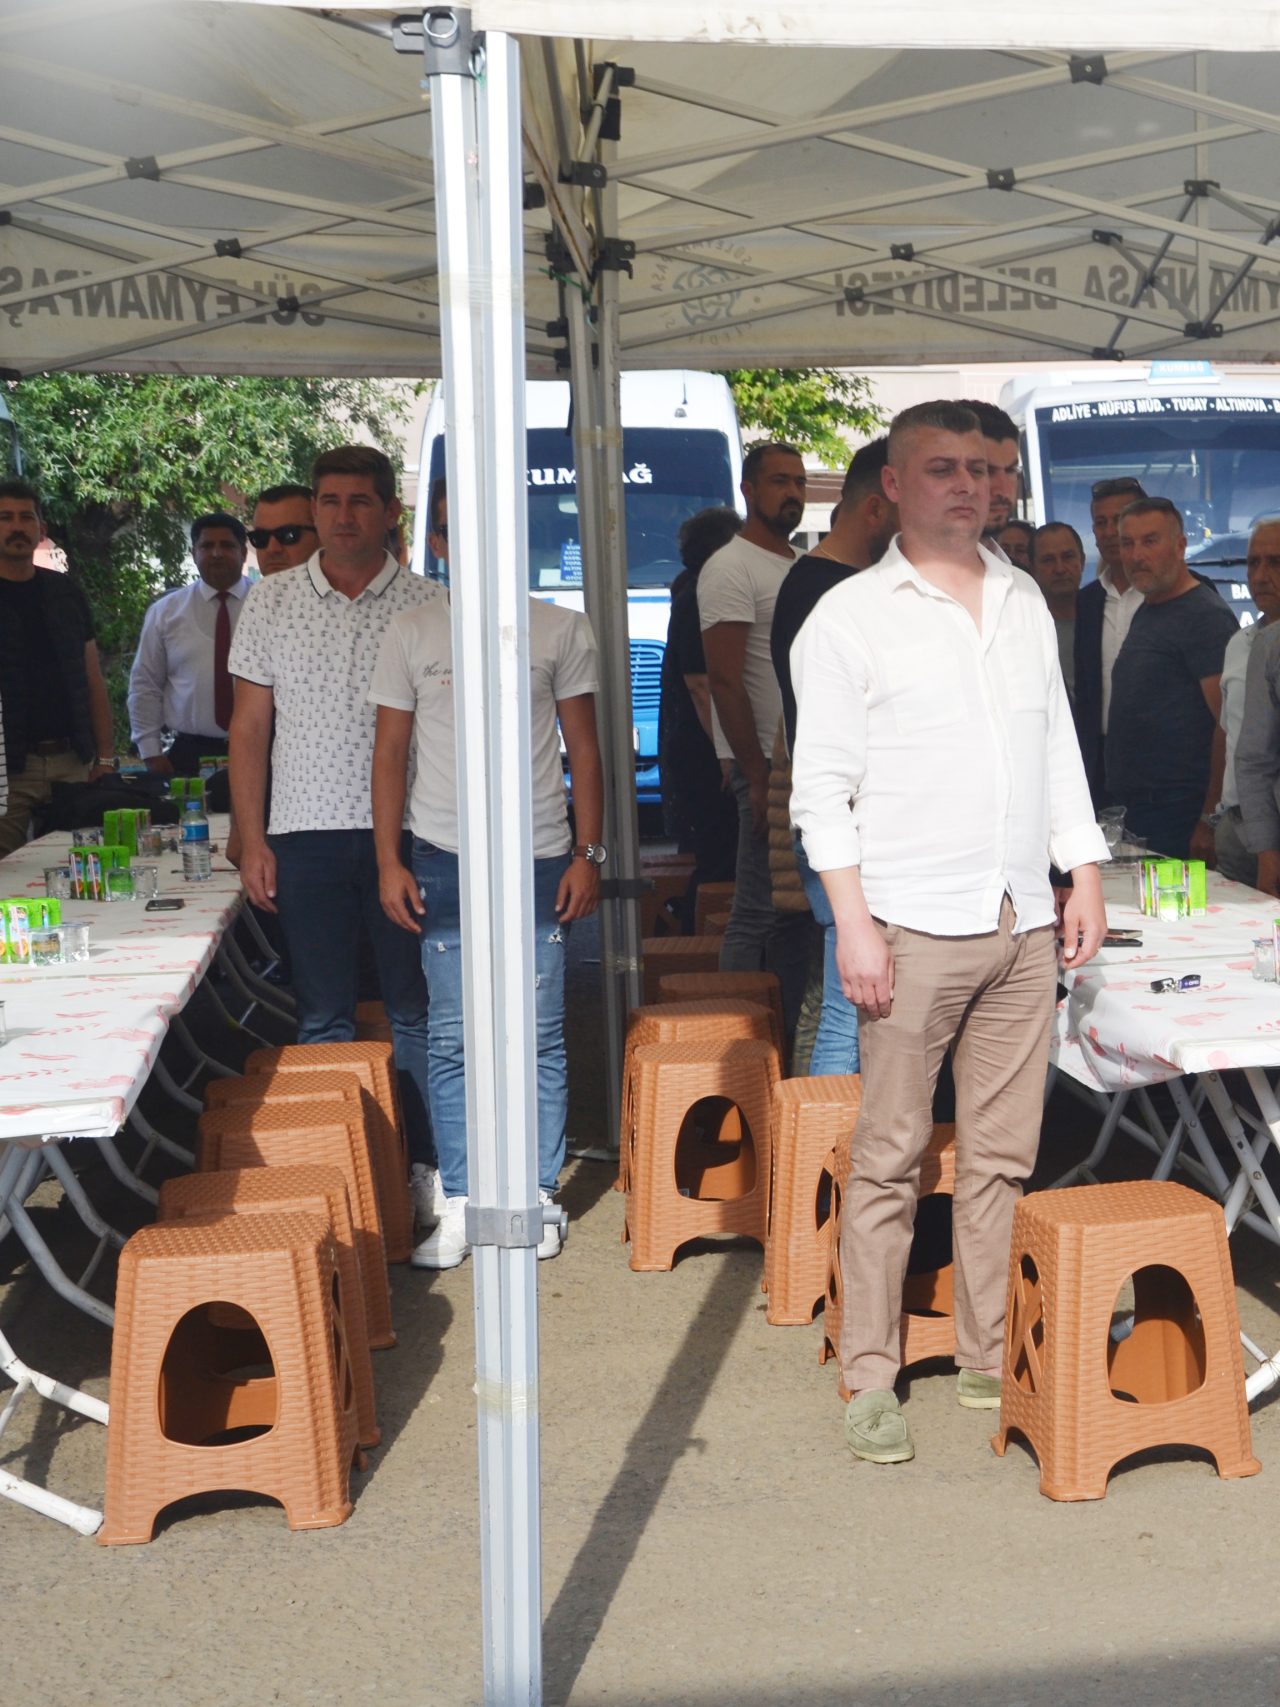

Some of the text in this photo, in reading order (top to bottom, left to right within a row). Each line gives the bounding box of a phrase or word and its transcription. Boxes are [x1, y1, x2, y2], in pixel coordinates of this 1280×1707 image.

[1052, 403, 1091, 423] ADLİYE
[1098, 399, 1136, 416] NÜFUS
[1171, 398, 1207, 412] TUGAY
[1216, 398, 1267, 413] ALTINOVA
